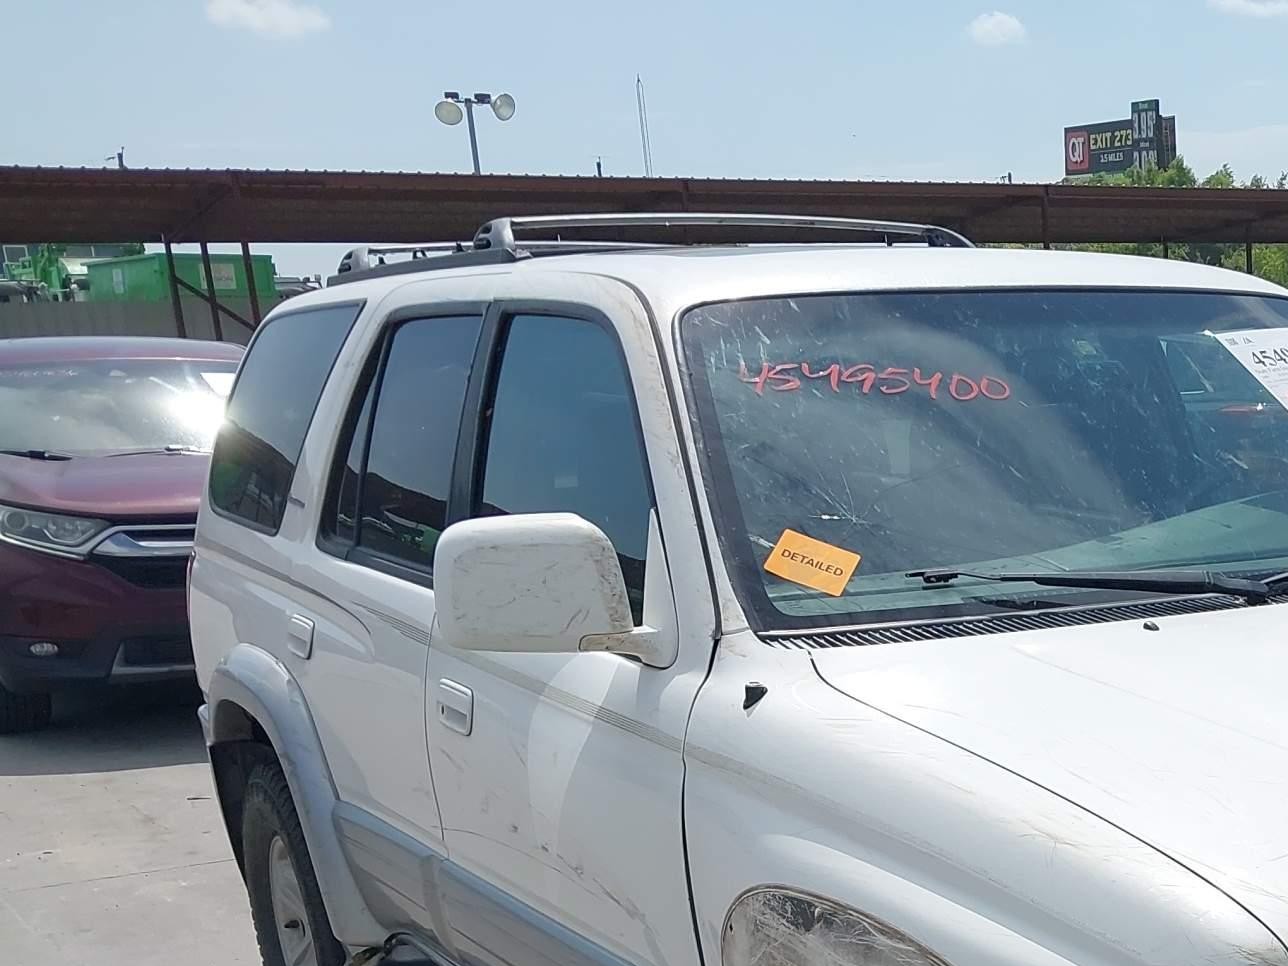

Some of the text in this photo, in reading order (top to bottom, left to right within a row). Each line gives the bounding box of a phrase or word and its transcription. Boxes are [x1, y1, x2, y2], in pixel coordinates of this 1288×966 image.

[1069, 137, 1084, 164] QT
[1090, 128, 1132, 150] EXIT 273
[1109, 152, 1124, 162] MILES
[739, 362, 1010, 400] 45495400
[781, 548, 844, 577] DETAILED
